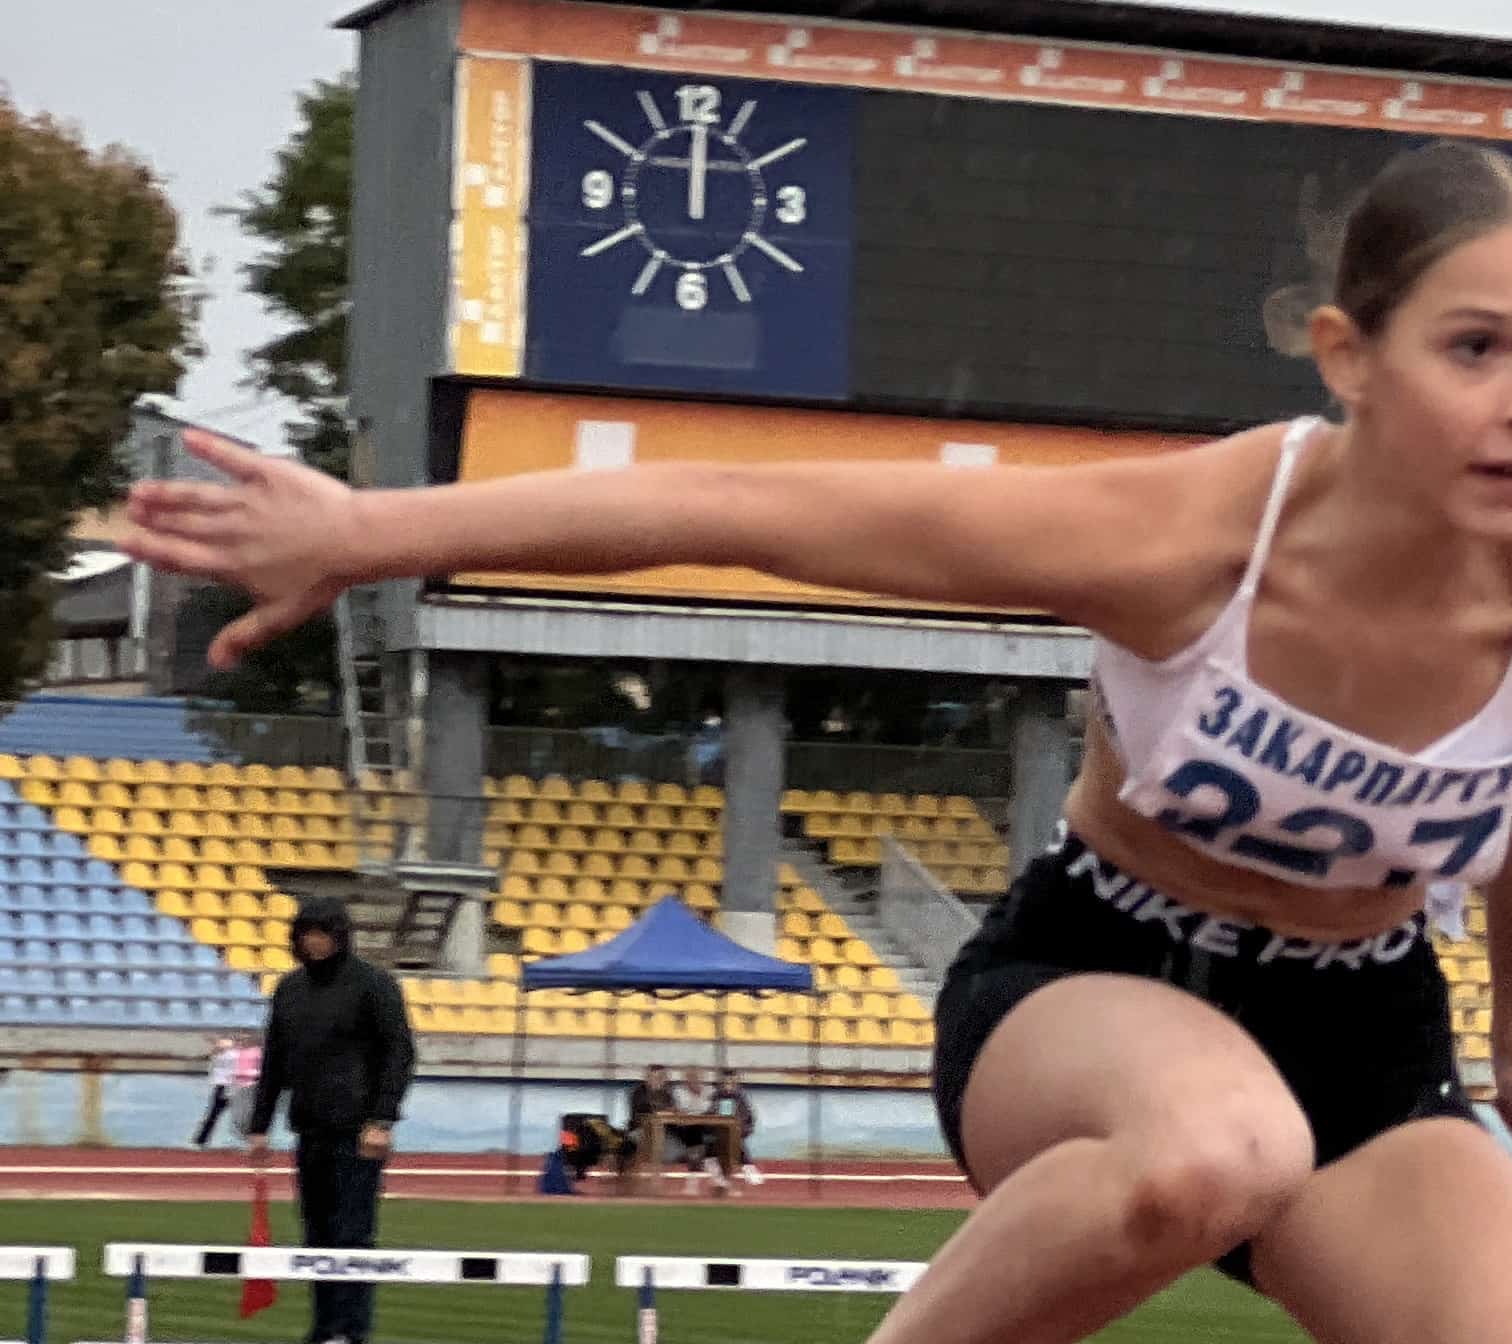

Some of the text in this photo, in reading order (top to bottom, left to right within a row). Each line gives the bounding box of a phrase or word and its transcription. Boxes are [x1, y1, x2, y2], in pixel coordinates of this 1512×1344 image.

[674, 85, 722, 124] 12
[582, 170, 614, 209] 9
[776, 186, 807, 224] 3
[676, 272, 708, 310] 6
[1066, 851, 1240, 957] NIKE
[290, 1254, 410, 1276] POLANIK
